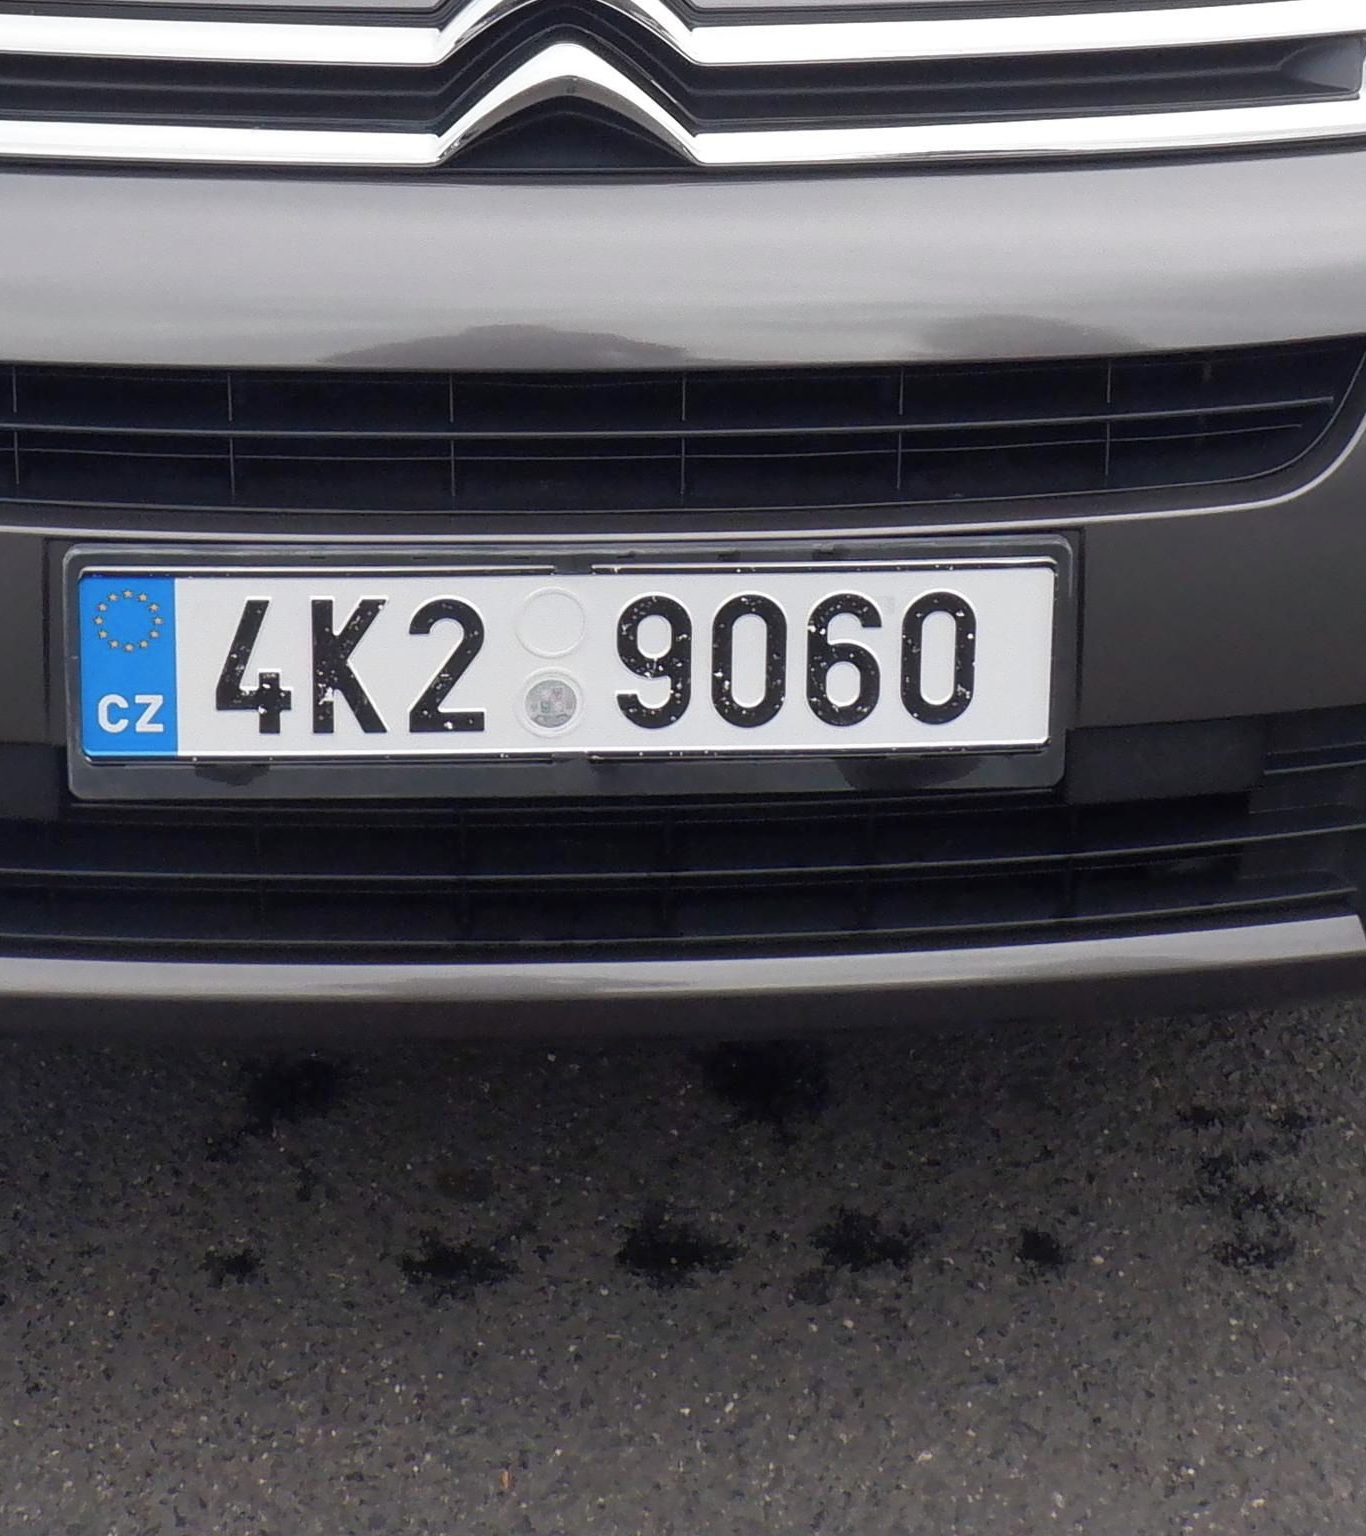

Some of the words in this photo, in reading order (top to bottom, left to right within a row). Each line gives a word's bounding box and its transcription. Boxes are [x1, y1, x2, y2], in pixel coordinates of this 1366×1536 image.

[215, 596, 486, 735] 4K2
[616, 590, 977, 729] 9060
[97, 693, 165, 734] CZ
